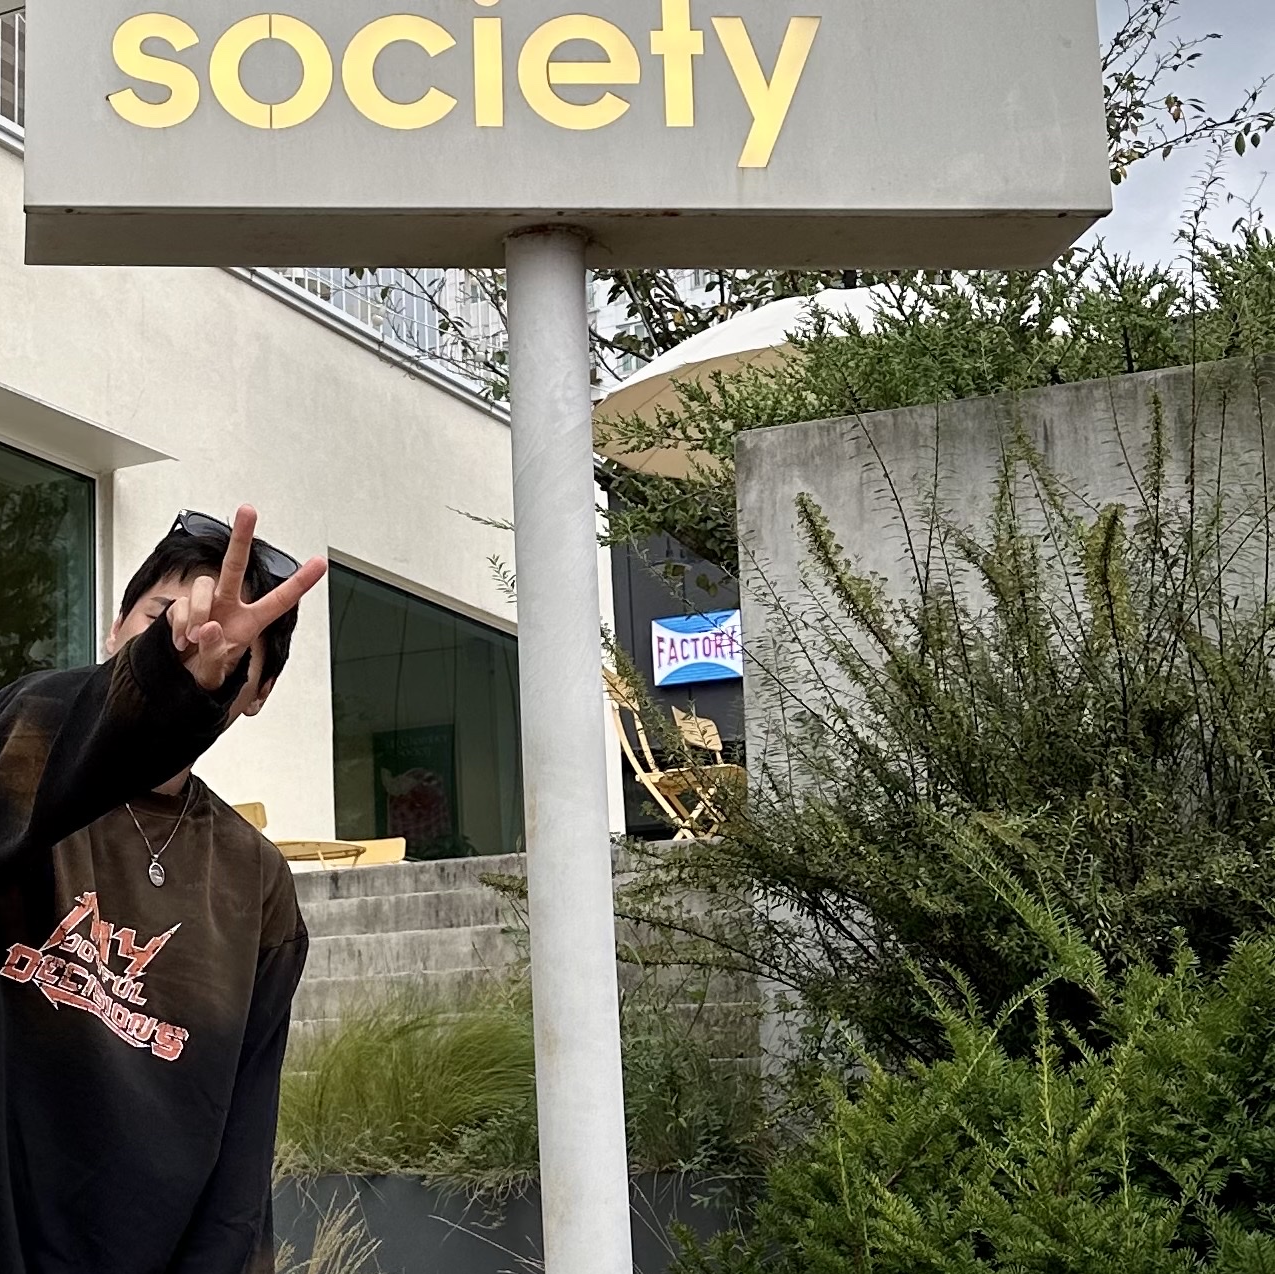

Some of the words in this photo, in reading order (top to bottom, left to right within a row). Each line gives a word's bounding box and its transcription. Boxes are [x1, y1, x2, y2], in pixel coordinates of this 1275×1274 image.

[108, 0, 823, 169] society
[656, 626, 738, 669] FACTORY
[0, 943, 190, 1061] DECISIONS
